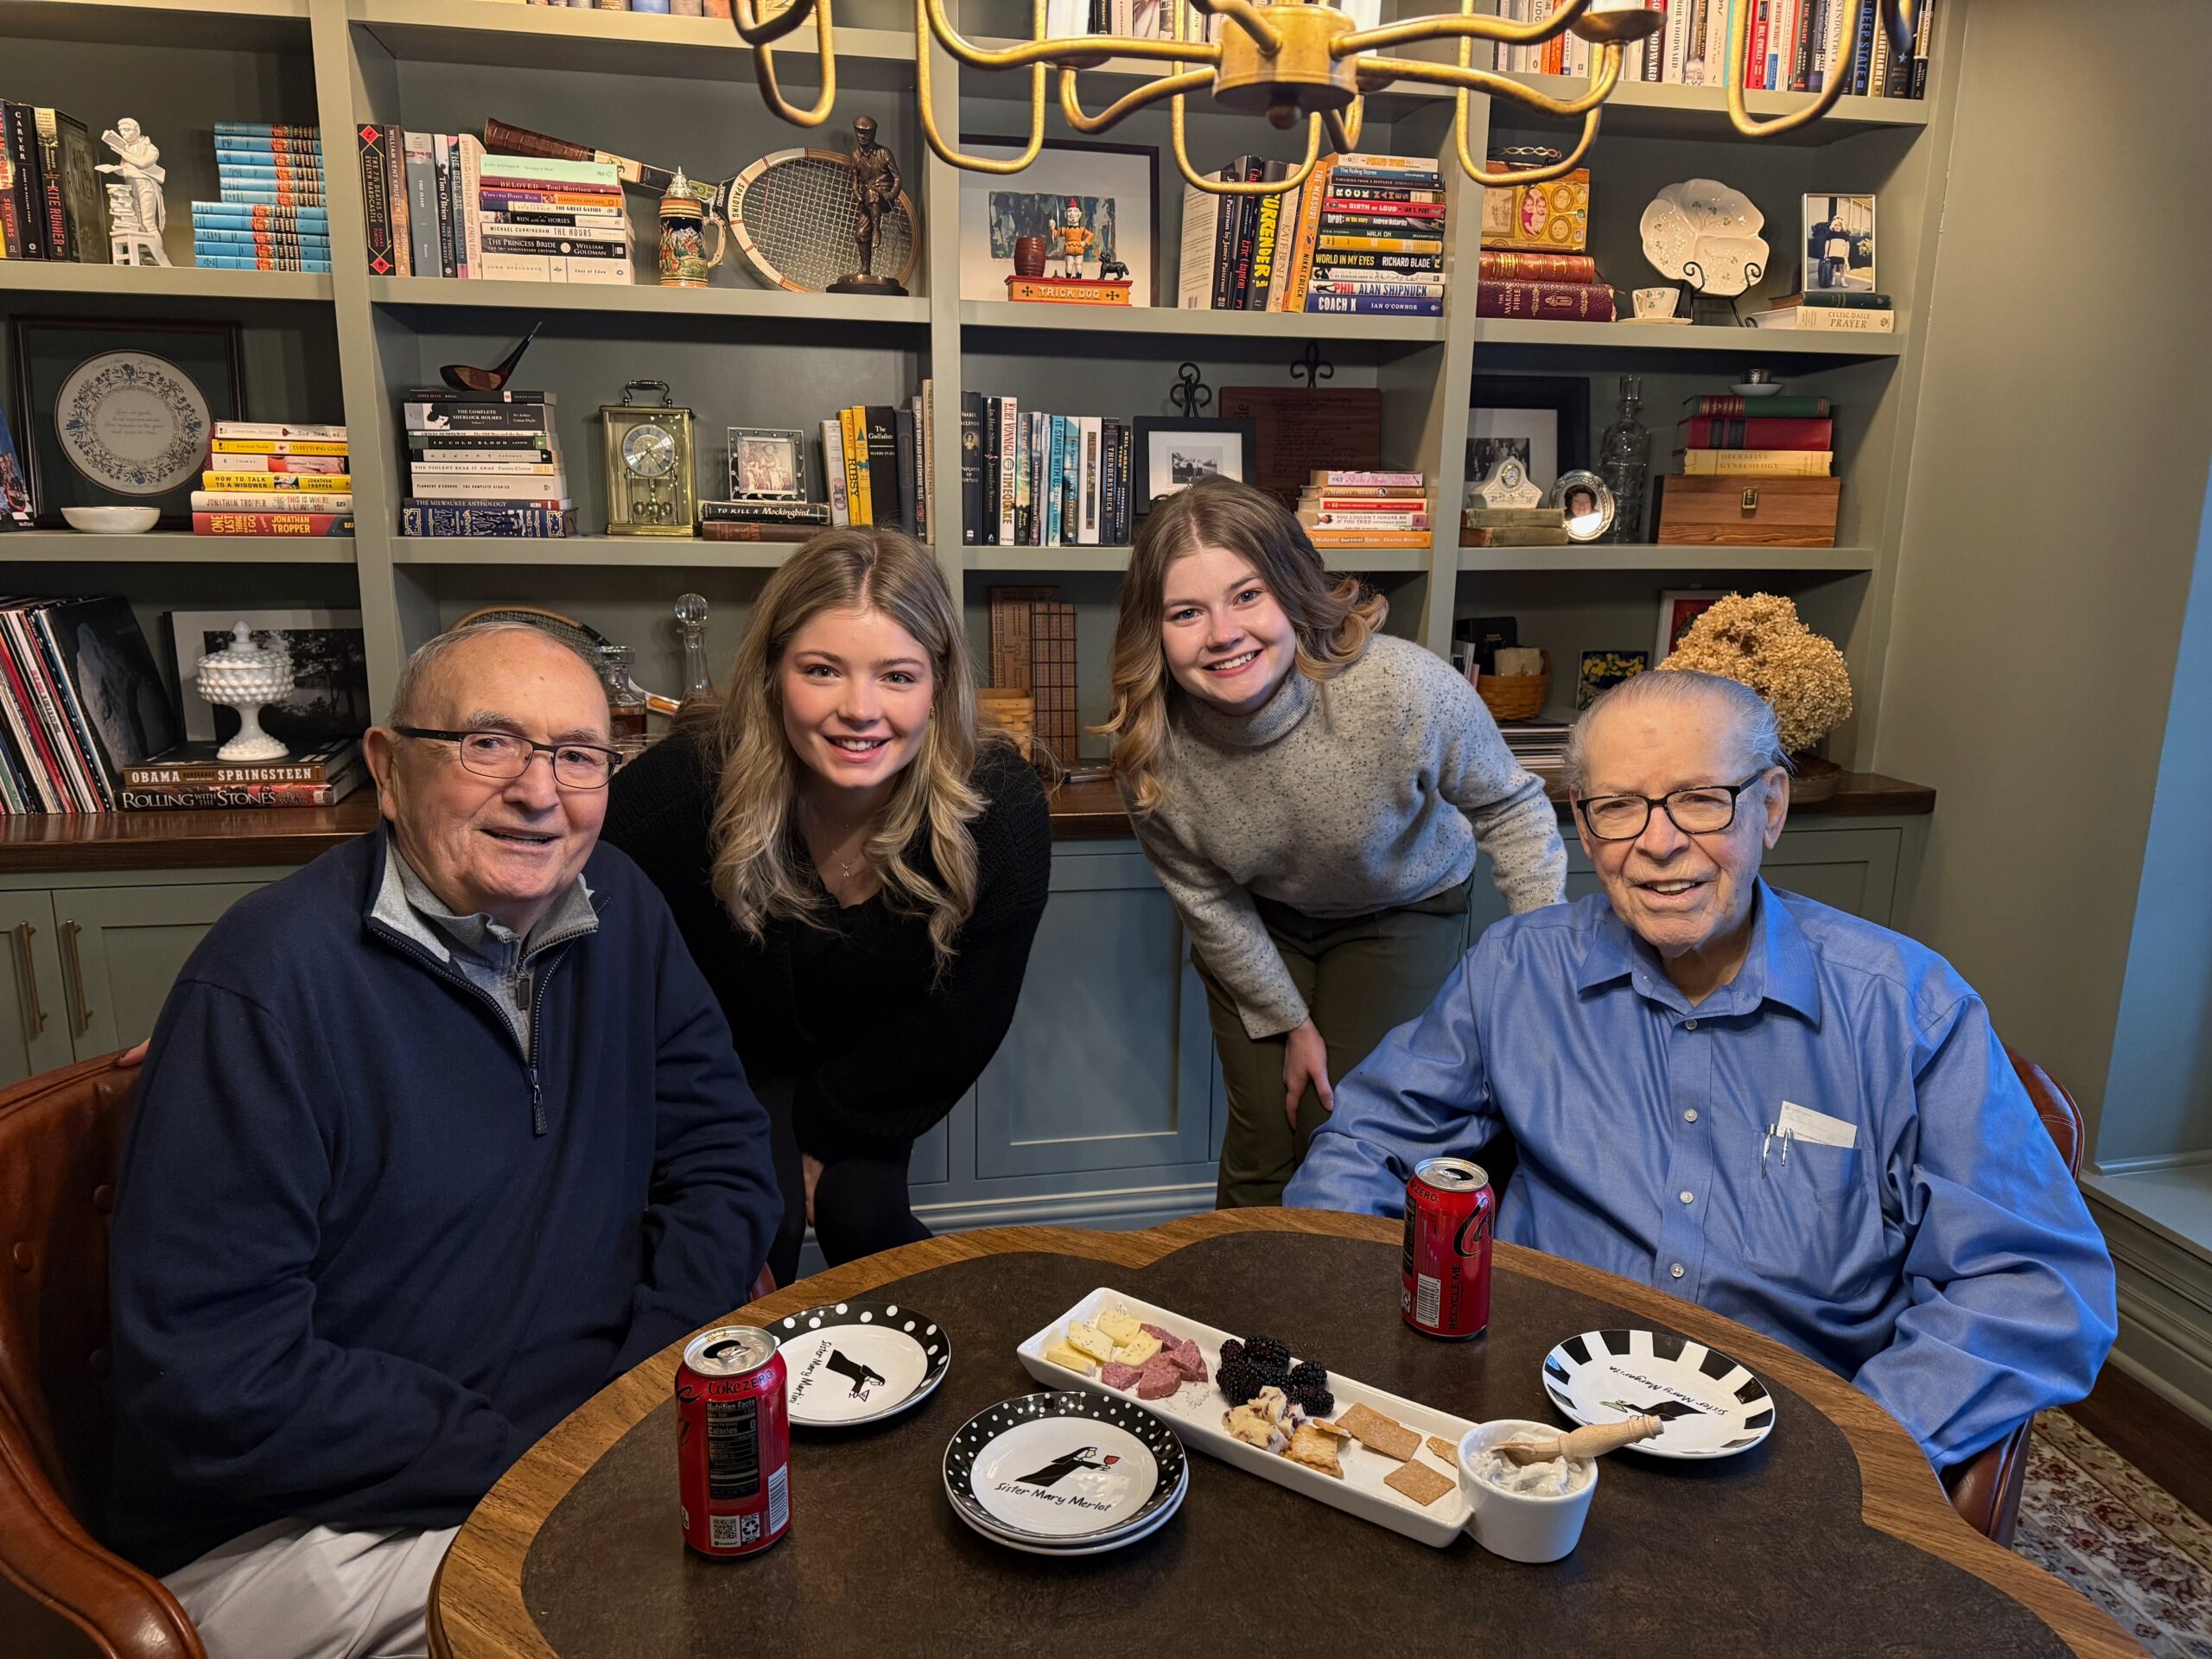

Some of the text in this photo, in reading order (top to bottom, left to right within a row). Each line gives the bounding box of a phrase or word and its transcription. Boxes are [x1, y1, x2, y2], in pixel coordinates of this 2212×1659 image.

[1672, 20, 1681, 68] WOODWARD
[1856, 7, 1873, 76] DEEP STATE
[16, 112, 25, 160] CARVER
[451, 170, 461, 191] BELL
[368, 181, 377, 223] HARDCASTLE
[454, 193, 462, 209] JAR
[732, 183, 745, 218] SPALDING
[1308, 184, 1320, 221] MEASURE
[1336, 188, 1409, 200] ROCK NAMES
[48, 186, 65, 245] KITE RUNNER
[440, 193, 449, 220] O'Brien
[1224, 200, 1233, 230] Patterson
[378, 213, 383, 223] OF
[1327, 214, 1344, 225] brat:
[503, 238, 534, 247] PRINCESS
[1225, 232, 1231, 240] by
[1276, 225, 1291, 277] KATE BUSH
[1316, 254, 1430, 268] WORLD IN MY EYES RICHARD BLADE
[1236, 239, 1251, 289] Eric Clapton
[1220, 262, 1229, 293] Patterson
[1296, 275, 1306, 299] ERLICK
[1039, 288, 1100, 298] TRICK DOG
[1334, 283, 1426, 296] PHIL ALAN SHIPNUCK
[1319, 297, 1347, 311] COACH
[1351, 298, 1357, 311] K
[1830, 319, 1867, 328] PRAYER
[1002, 403, 1015, 524] KURT TIMEQUAKE
[848, 458, 859, 498] RIBSY
[1106, 447, 1115, 512] THUNDERSTRUCK
[211, 515, 225, 532] ONE
[224, 514, 235, 533] LAST
[762, 507, 810, 519] Mockingbird
[272, 524, 310, 533] TROPPER
[131, 771, 181, 783] OBAMA
[218, 768, 311, 781] SPRINGSTEEN
[122, 792, 194, 809] ROLLING
[217, 791, 276, 806] STONES
[1414, 1185, 1438, 1203] ZERO
[1448, 1263, 1461, 1331] RECYCLE ME
[709, 1370, 773, 1395] Coke ZERO
[789, 1340, 831, 1405] Sister Mary Martini
[1610, 1365, 1729, 1415] Sister Mary Margarita
[737, 1399, 755, 1409] Facts
[750, 1419, 756, 1429] 0
[994, 1483, 1112, 1511] Sister Mary Merlot
